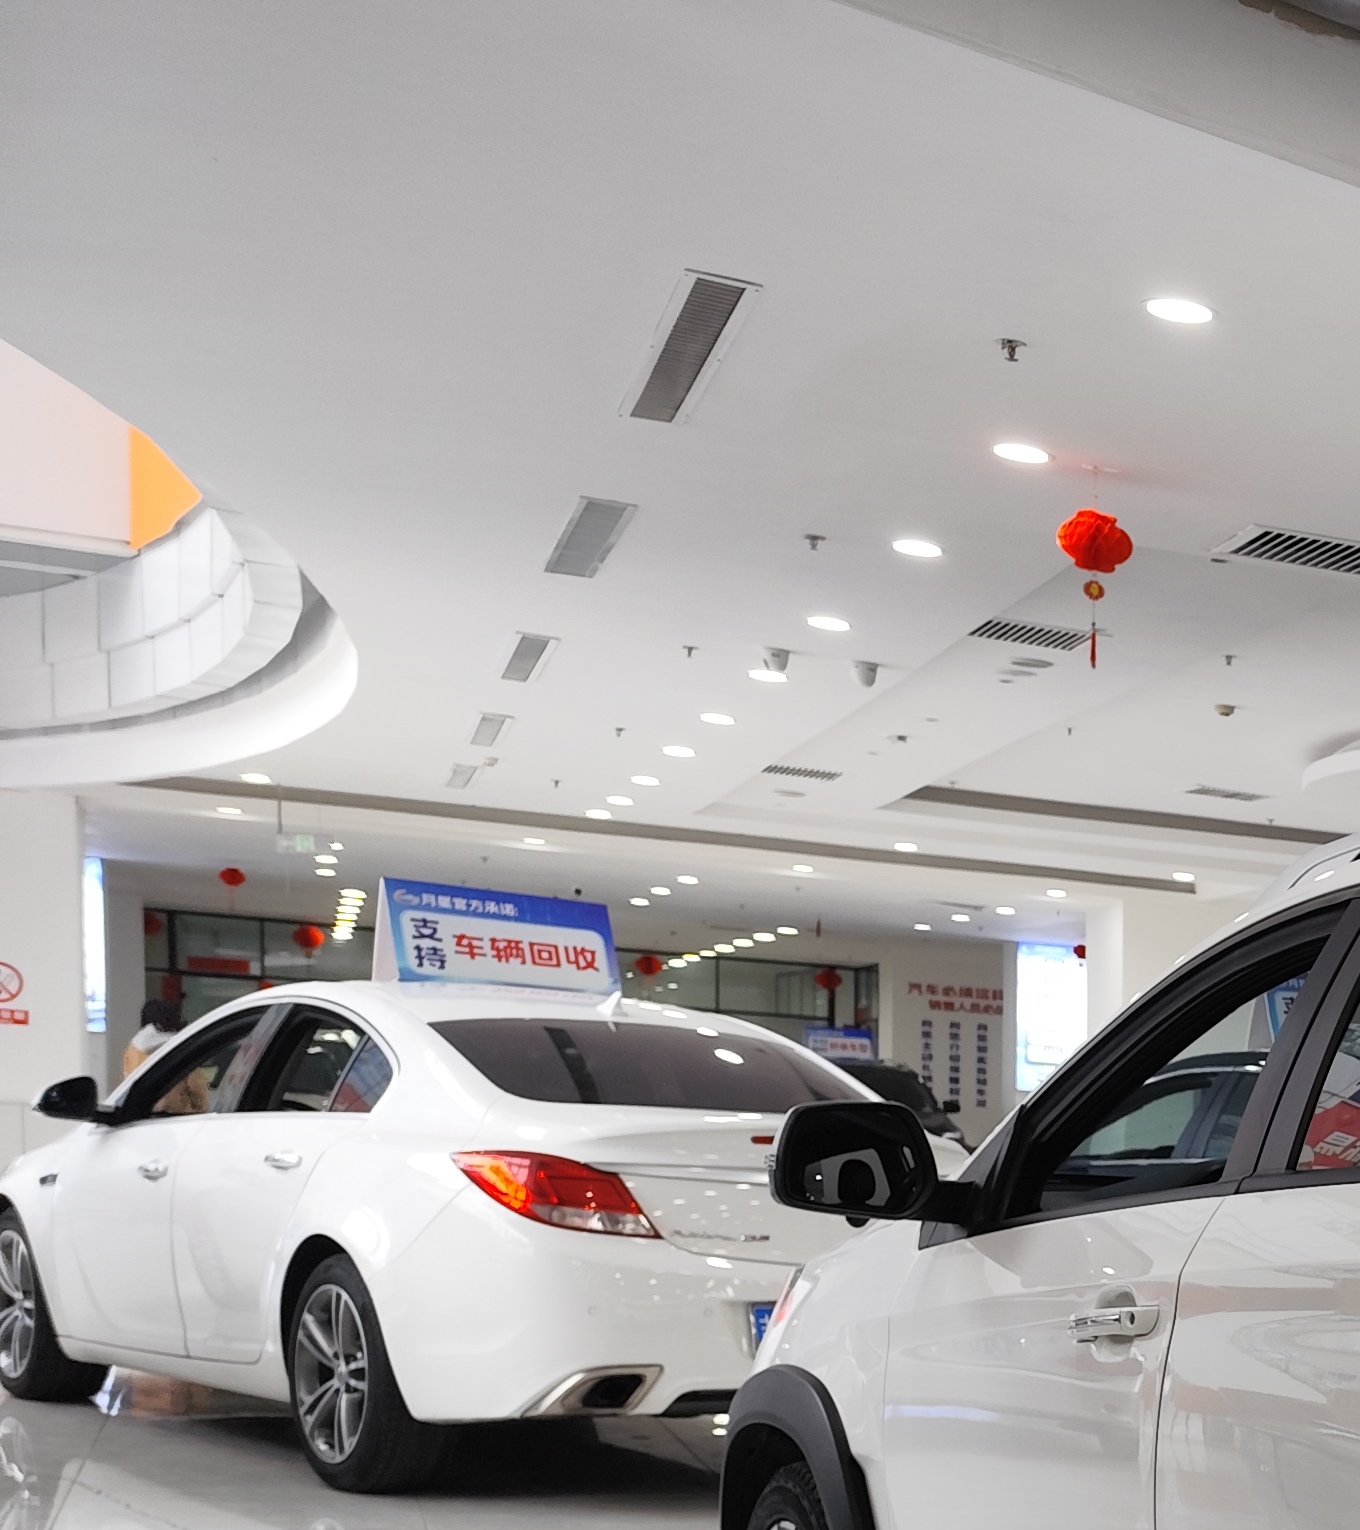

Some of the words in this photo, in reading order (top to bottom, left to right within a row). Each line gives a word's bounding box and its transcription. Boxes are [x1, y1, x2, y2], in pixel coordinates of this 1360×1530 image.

[410, 917, 447, 970] 支持
[452, 933, 600, 972] 车辆回收
